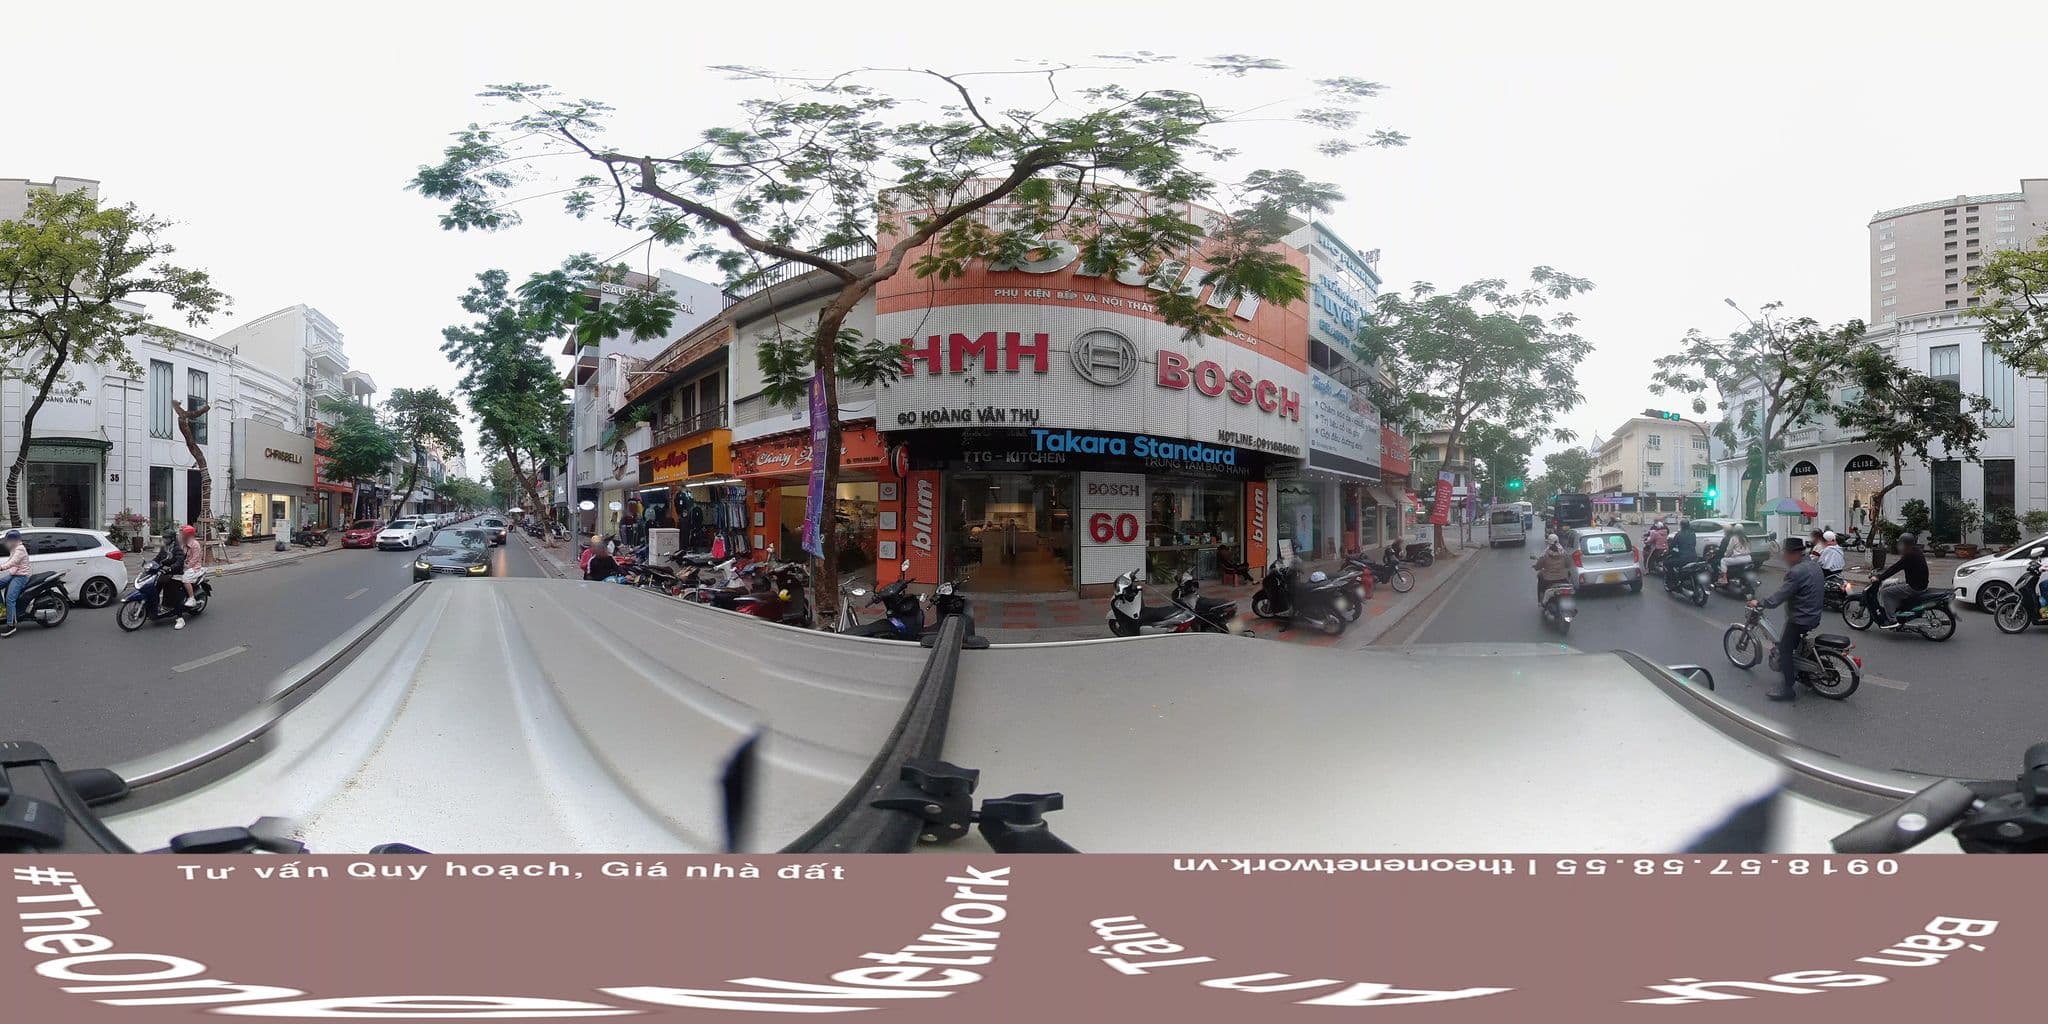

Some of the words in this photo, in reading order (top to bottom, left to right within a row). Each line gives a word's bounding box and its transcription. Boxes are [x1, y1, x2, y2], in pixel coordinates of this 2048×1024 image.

[994, 289, 1018, 299] PHỤ
[1024, 288, 1051, 300] KIỆN
[1082, 292, 1098, 303] VÀ
[1102, 296, 1122, 308] NỘI
[900, 331, 1049, 377] HMH
[1156, 348, 1300, 423] BOSCH
[921, 406, 972, 424] HOÀNG
[977, 405, 1006, 423] VĂN
[1010, 408, 1040, 426] THỤ
[1005, 451, 1066, 464] KITCHEN
[1031, 429, 1127, 456] Takara
[1133, 435, 1236, 466] Standard
[1144, 456, 1180, 469] TRUNG
[1795, 466, 1812, 474] ELISE
[1852, 460, 1875, 469] ELISE
[110, 473, 120, 482] 35
[1088, 483, 1140, 496] BOSCH
[911, 479, 933, 552] blum
[1252, 488, 1264, 543] blum
[1089, 512, 1140, 543] 60
